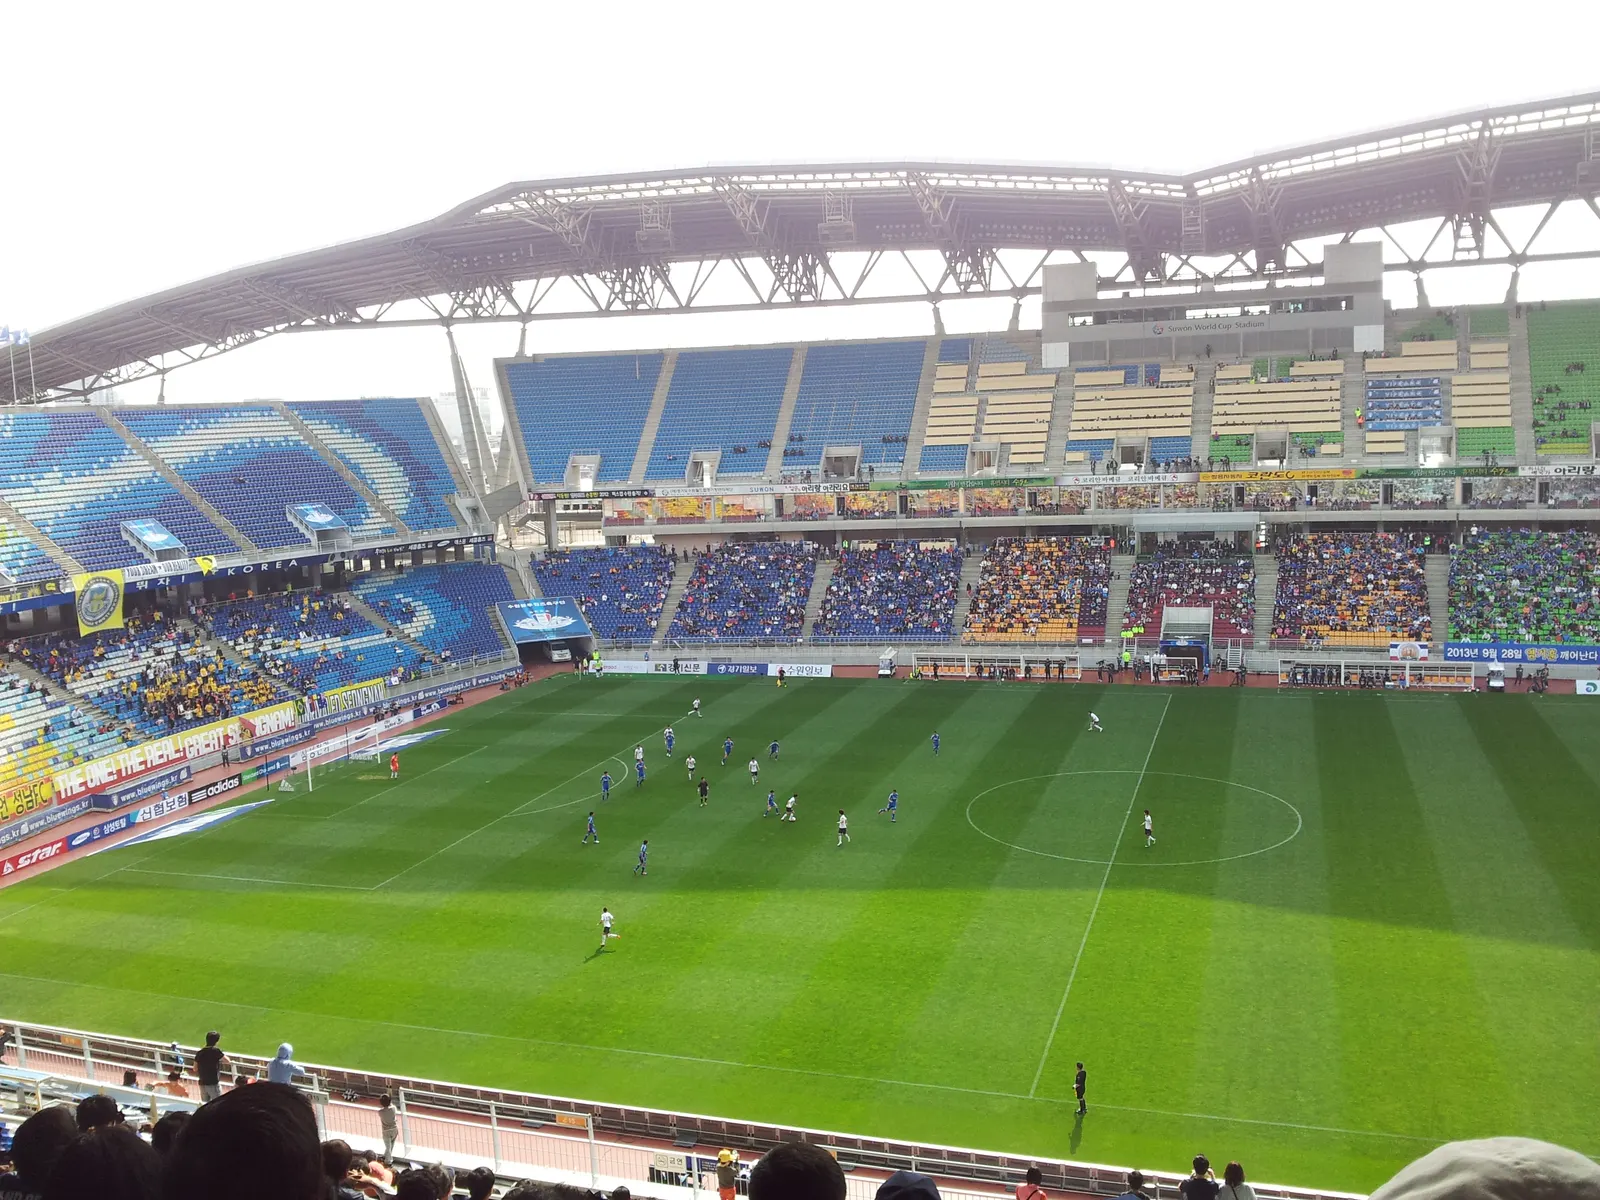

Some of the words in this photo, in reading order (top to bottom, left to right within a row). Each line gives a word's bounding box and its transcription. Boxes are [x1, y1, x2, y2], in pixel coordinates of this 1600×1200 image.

[1194, 323, 1216, 331] World
[1235, 321, 1265, 329] Stadium
[1554, 465, 1597, 475] 아리랑
[801, 484, 821, 493] 아리랑
[823, 483, 849, 492] 아라리요
[227, 558, 298, 577] KOREA
[1447, 647, 1479, 659] 2013년
[1482, 647, 1497, 659] 9월
[1501, 648, 1523, 659] 28일
[1560, 649, 1599, 661] 깨어난다
[727, 665, 757, 673] 경기일보
[787, 664, 823, 676] 수원일보
[341, 682, 385, 711] SEONGNAM
[254, 729, 311, 752] www.bluewings.kr
[55, 769, 86, 799] THE
[85, 757, 118, 788] ONE!
[117, 750, 147, 777] THE
[144, 735, 185, 768] REAL!
[184, 725, 227, 758] GREAT
[120, 774, 178, 802] www.bluewings.kr
[207, 776, 240, 797] adidas
[28, 799, 89, 831] www.bluewings.kr
[140, 791, 188, 822] 신협보험
[669, 1156, 683, 1166] 금연
